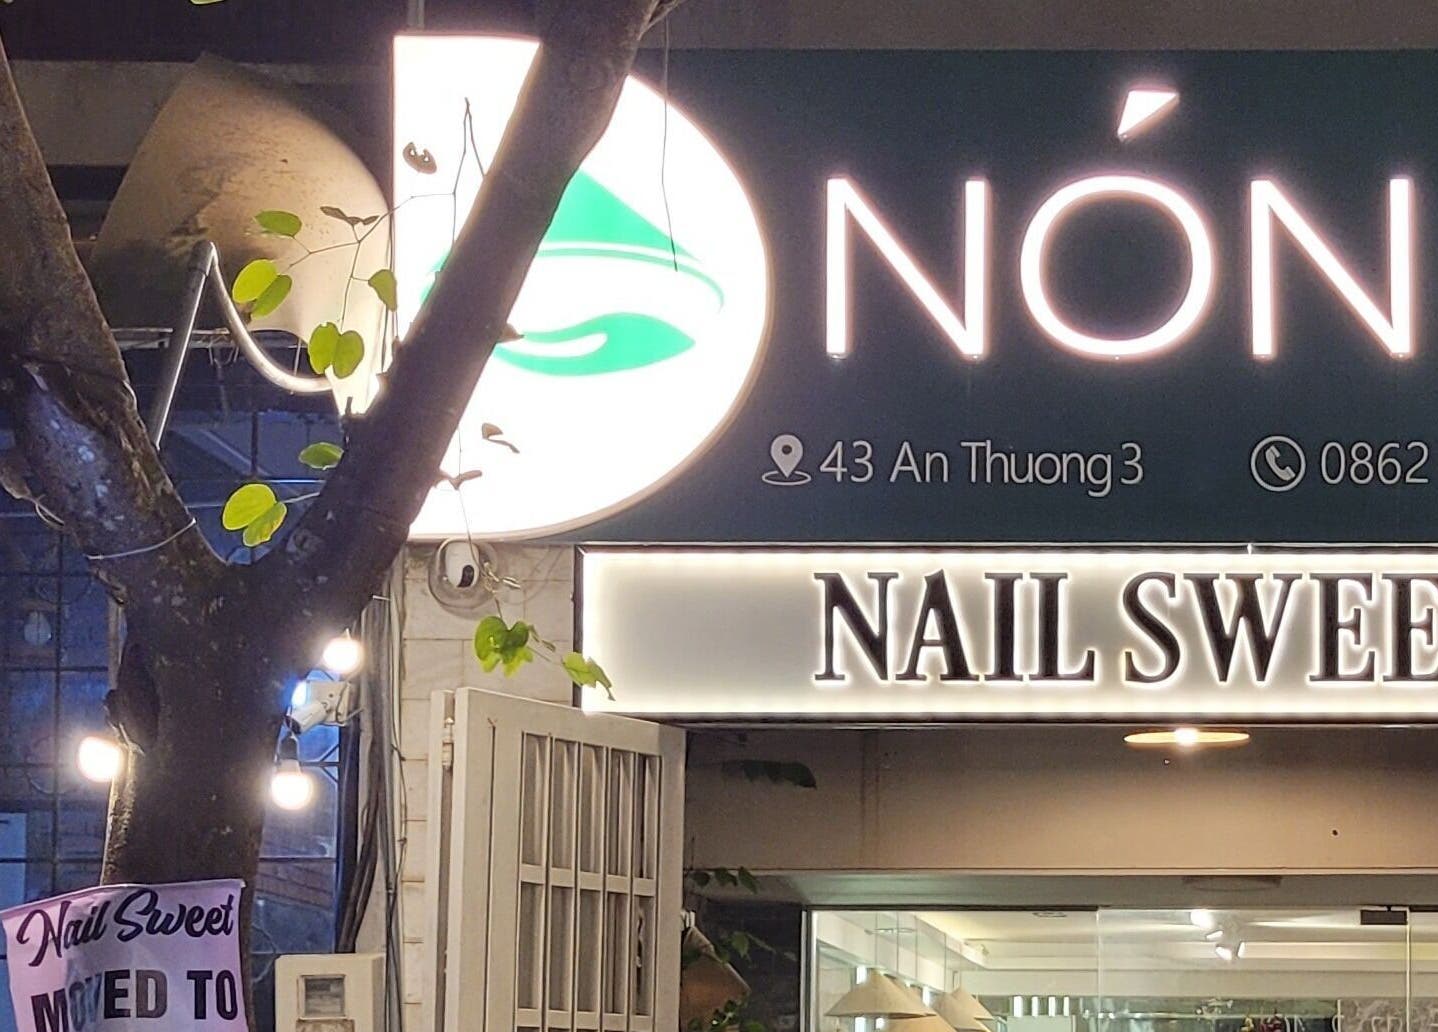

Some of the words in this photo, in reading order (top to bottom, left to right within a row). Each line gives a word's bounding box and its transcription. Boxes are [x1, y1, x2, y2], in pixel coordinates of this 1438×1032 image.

[826, 90, 1412, 359] NÓN
[819, 440, 874, 483] 43
[890, 441, 948, 483] An
[961, 439, 1111, 497] Thuong
[1121, 441, 1144, 484] 3
[1321, 441, 1429, 485] 0862
[813, 569, 1096, 681] NAIL
[16, 901, 110, 967] Nail
[114, 888, 236, 942] Sweet
[187, 969, 239, 1021] TO
